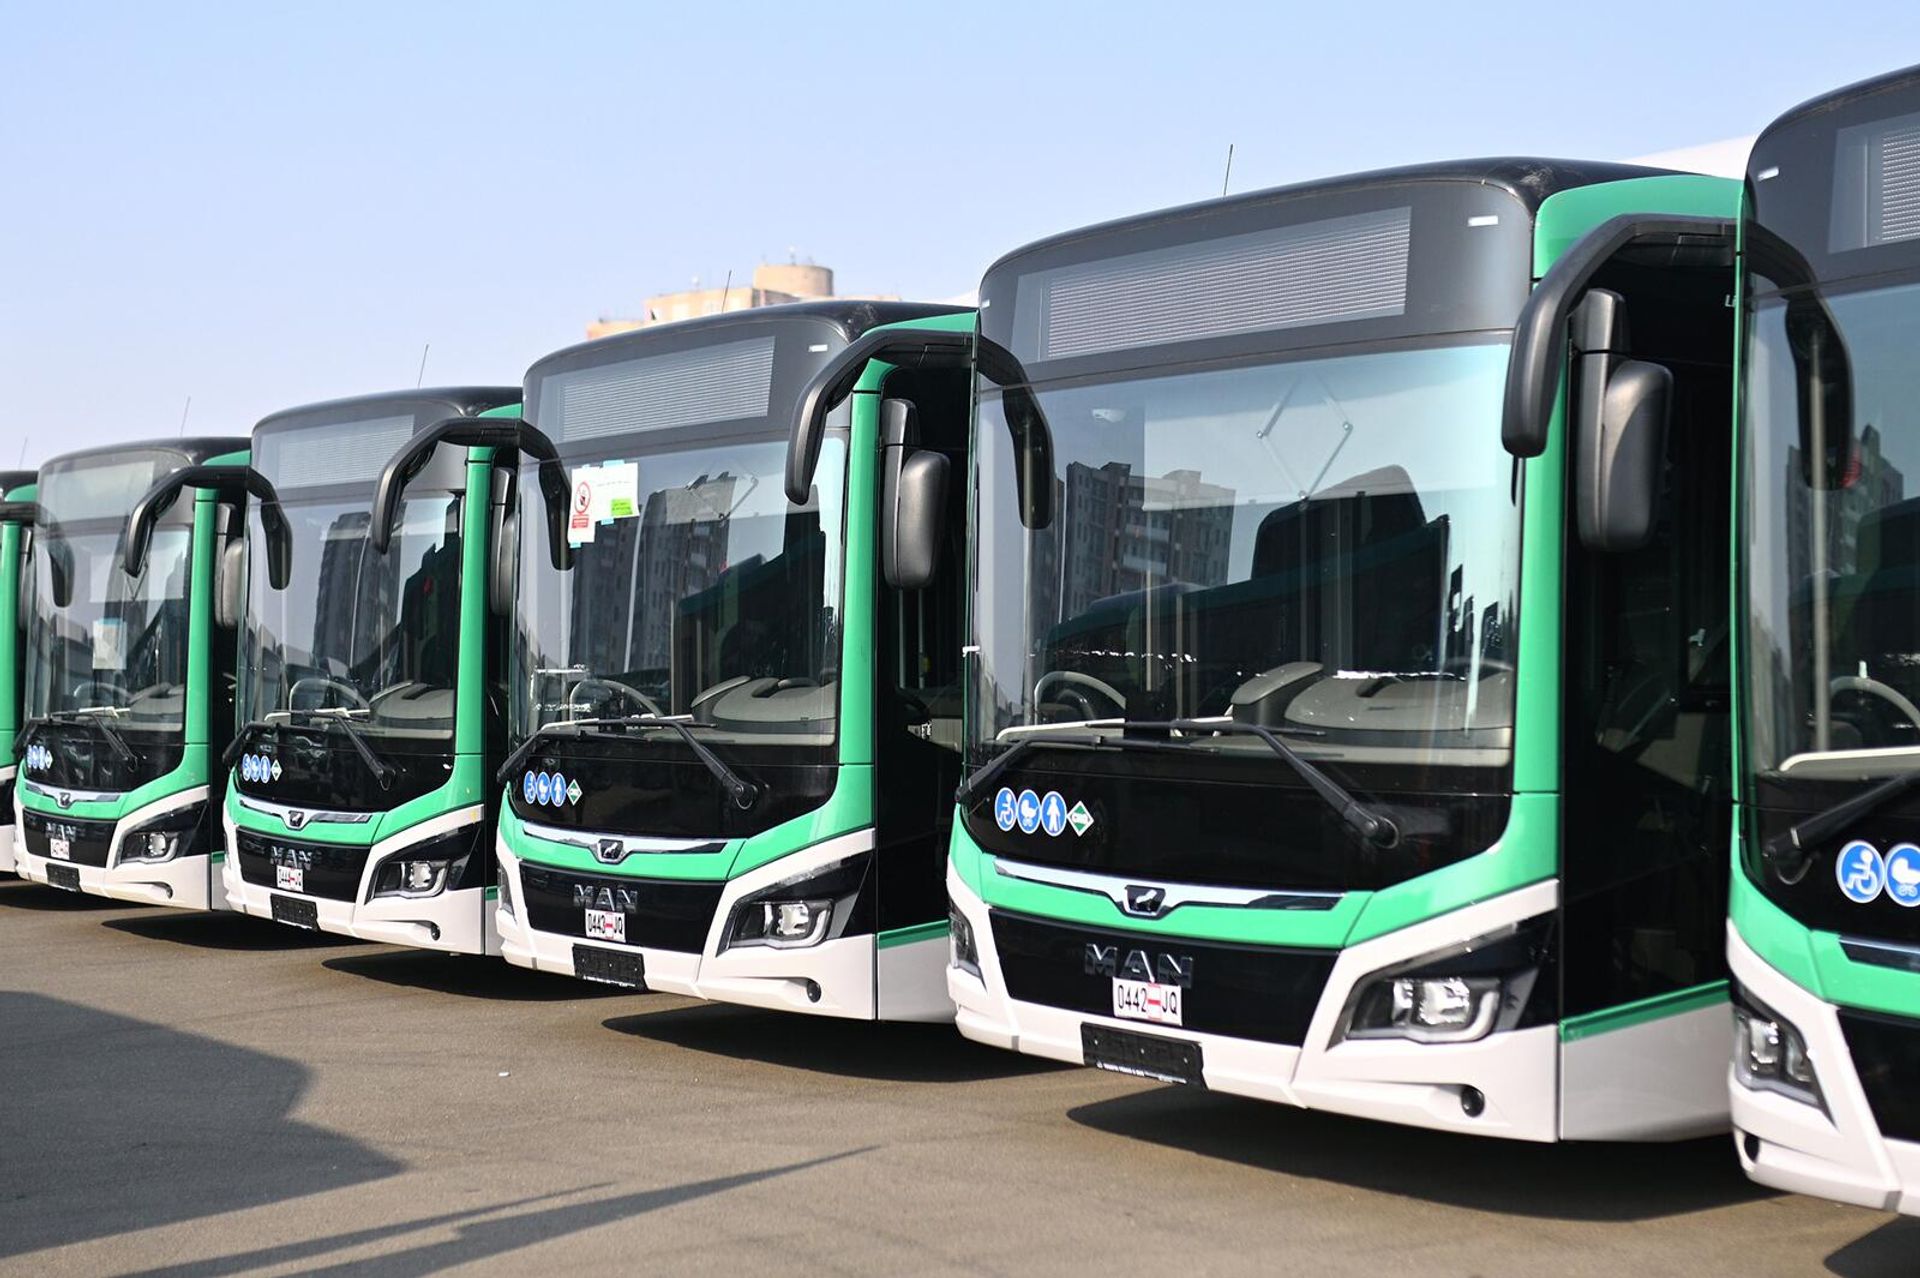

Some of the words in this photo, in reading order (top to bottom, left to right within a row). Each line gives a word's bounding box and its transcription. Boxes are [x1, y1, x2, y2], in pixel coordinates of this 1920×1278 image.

[270, 846, 311, 871] MAN
[573, 884, 637, 912] MAN
[1084, 944, 1193, 989] MAN
